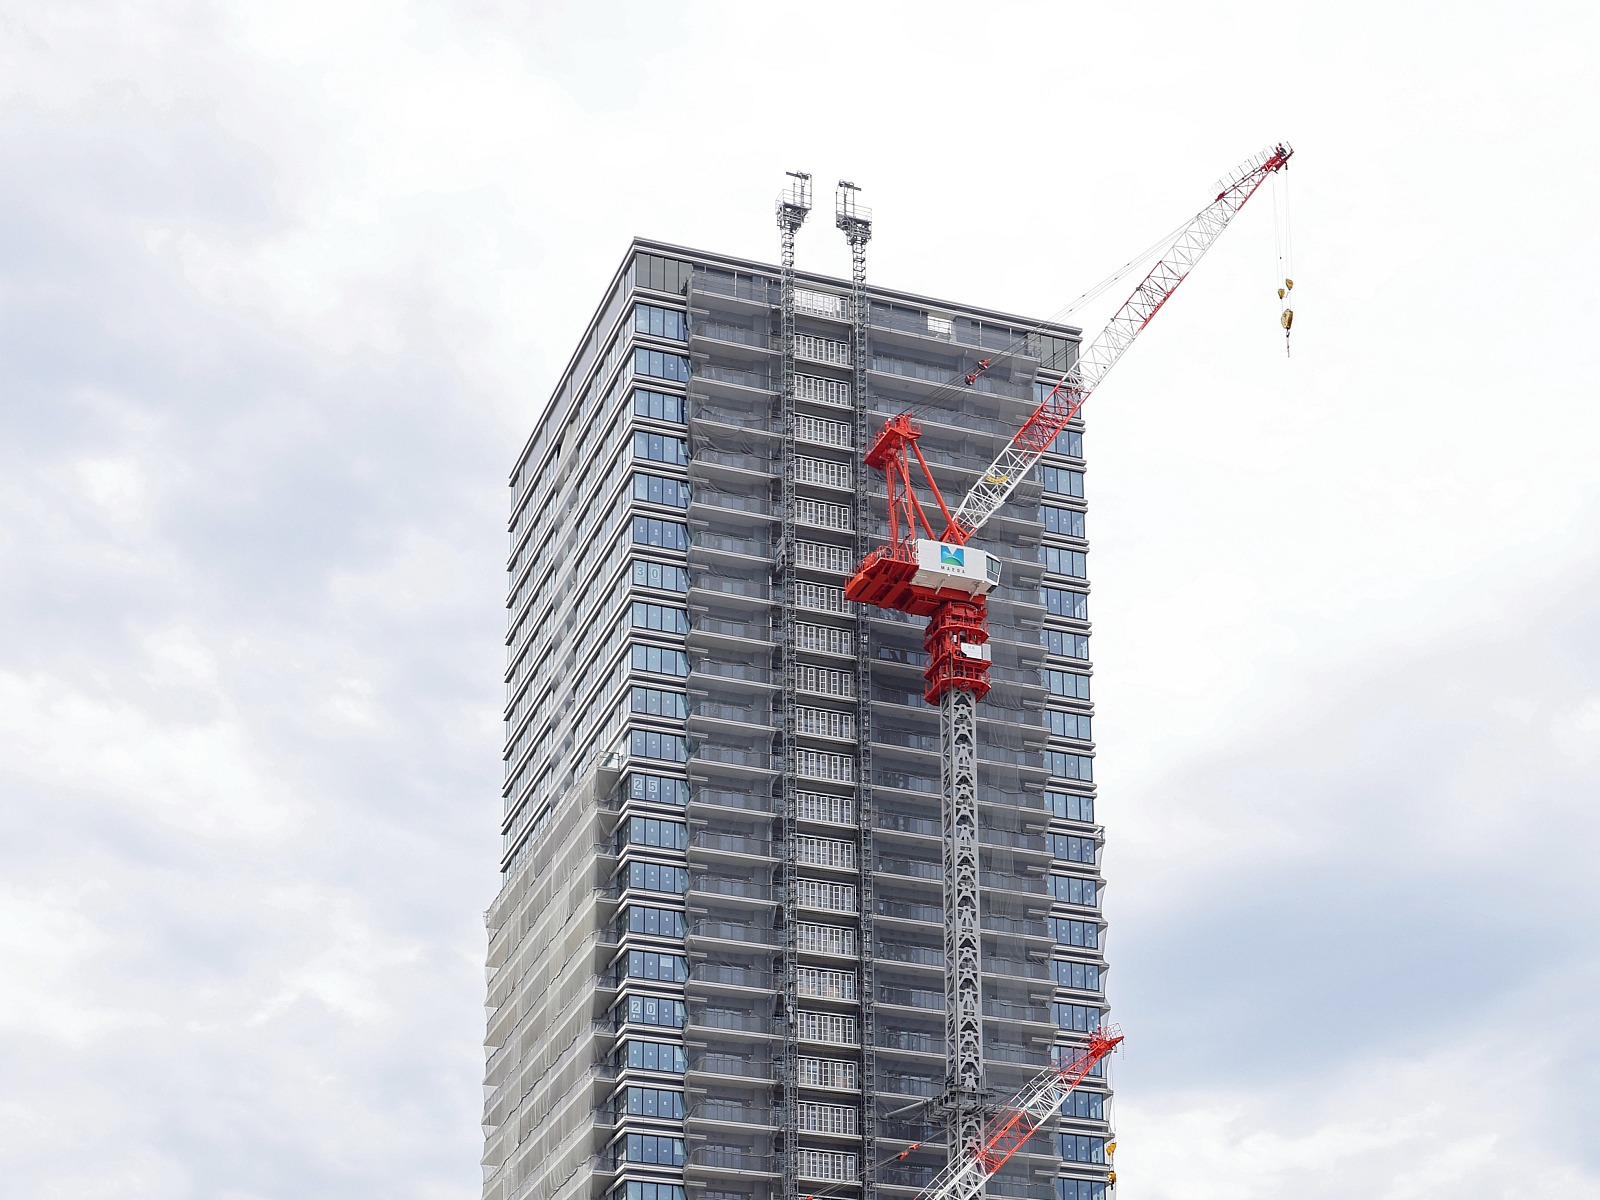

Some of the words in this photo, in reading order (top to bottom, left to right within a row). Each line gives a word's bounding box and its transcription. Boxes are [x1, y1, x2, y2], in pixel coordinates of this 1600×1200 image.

[637, 566, 659, 578] 30
[940, 565, 965, 574] MAEDA
[634, 779, 656, 792] 25
[632, 1001, 655, 1014] 20
